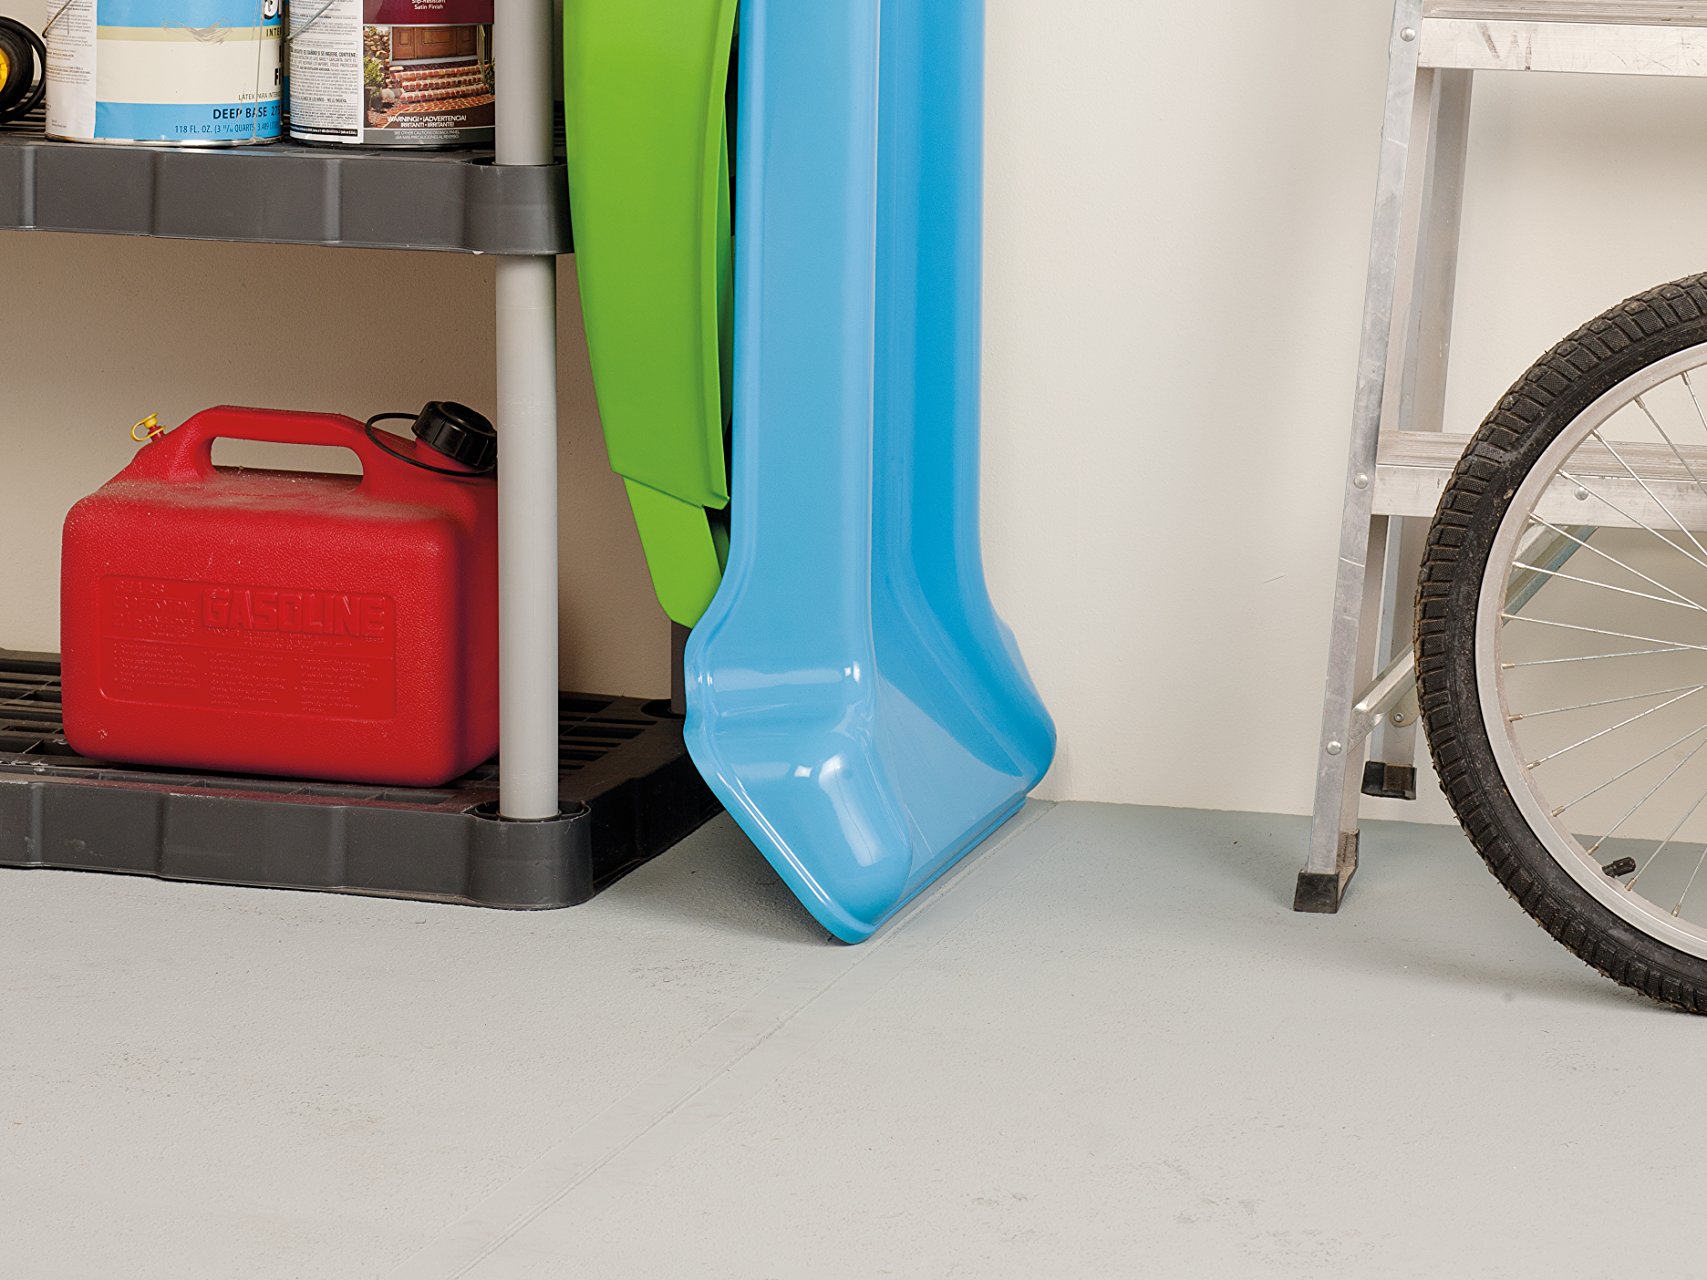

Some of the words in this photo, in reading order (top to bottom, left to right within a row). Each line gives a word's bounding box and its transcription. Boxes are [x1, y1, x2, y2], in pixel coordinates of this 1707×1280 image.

[213, 108, 242, 119] DEEP
[245, 107, 267, 118] BASE
[175, 125, 188, 134] 118
[189, 124, 200, 133] FL.
[201, 124, 212, 133] OZ.
[204, 587, 385, 640] GASOLINE
